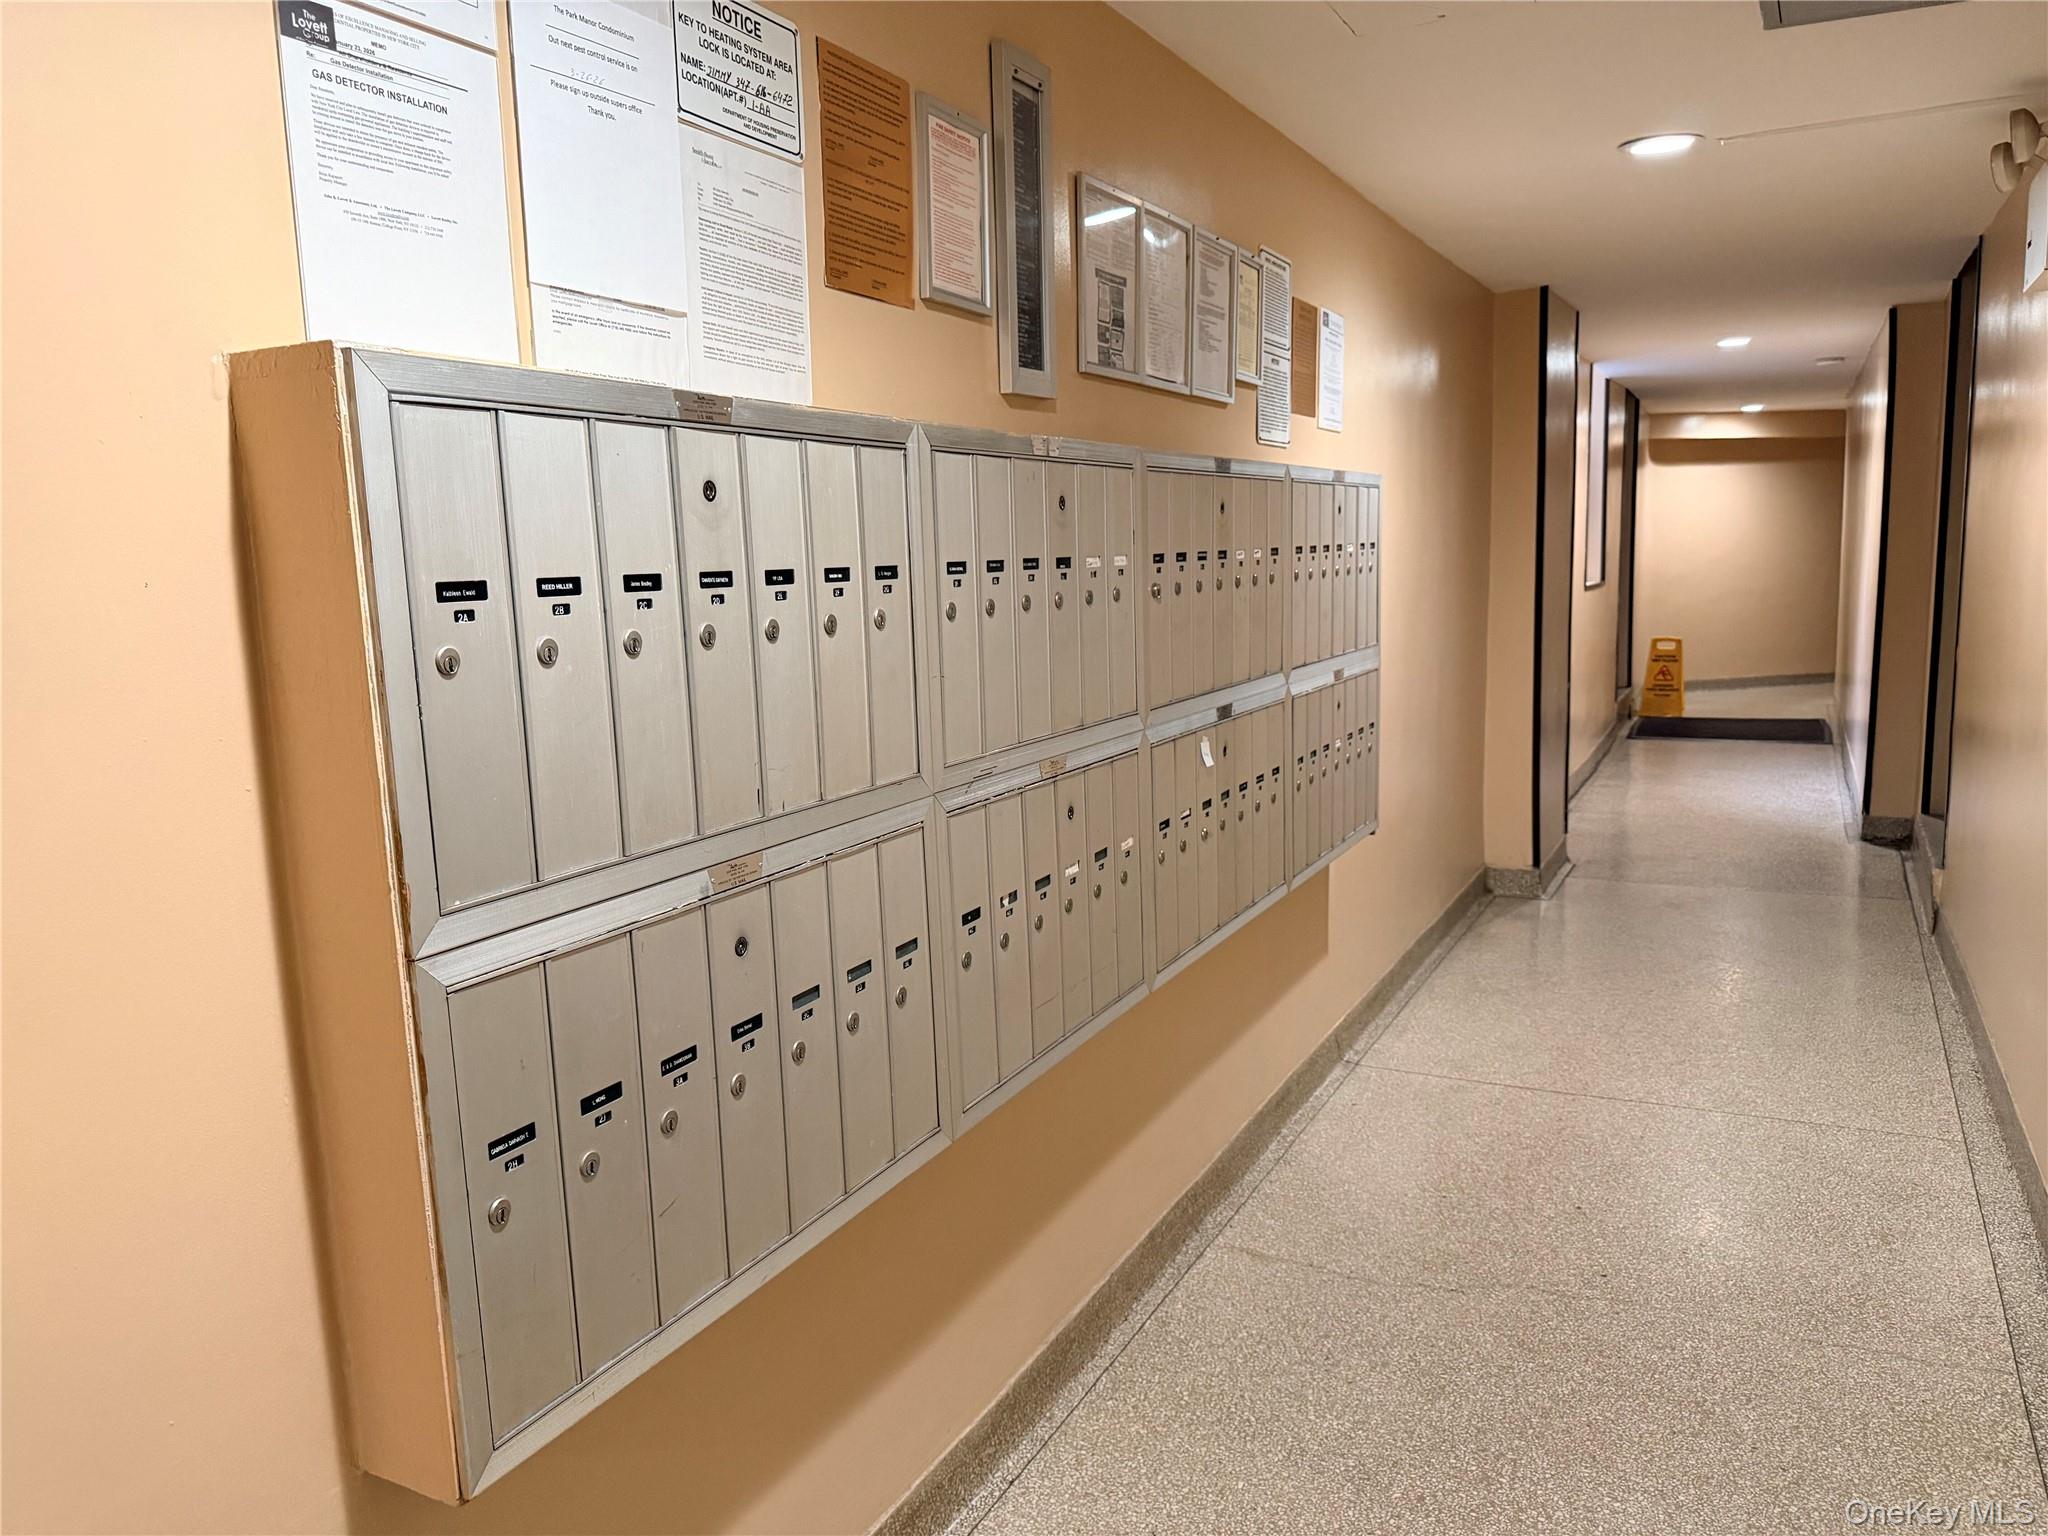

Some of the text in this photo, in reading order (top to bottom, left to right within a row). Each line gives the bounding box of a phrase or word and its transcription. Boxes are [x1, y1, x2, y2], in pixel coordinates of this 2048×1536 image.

[291, 12, 328, 35] Lovett
[302, 9, 316, 20] The
[553, 4, 635, 42] The Park Manor Condominium
[712, 0, 762, 39] NOTICE
[302, 28, 330, 43] Group
[370, 40, 387, 51] MEMO
[678, 12, 793, 75] KEY TO HEATING SYSTEM AREA
[363, 47, 376, 56] 2026
[548, 34, 560, 46] Out
[560, 39, 573, 49] next
[574, 43, 585, 54] pest
[587, 48, 606, 61] control
[607, 56, 625, 69] service
[625, 62, 631, 70] is
[699, 36, 776, 81] LOCK IS LOCATED AT:
[330, 57, 341, 66] Gas
[342, 61, 364, 73] Detector
[365, 67, 394, 81] Installation
[680, 52, 706, 72] NAME:
[707, 65, 732, 84] JIMMY
[311, 68, 448, 116] GAS DETECTOR INSTALLATION
[550, 79, 643, 115] Please sign up outside supers office
[588, 105, 616, 122] Thank you.
[722, 106, 797, 141] DEPARTMENT OF HOUSING PRESERVATION
[751, 126, 778, 140] DEVELOPMENT
[457, 613, 469, 623] 2A
[554, 605, 565, 615] 2B
[507, 1160, 518, 1170] 2H
